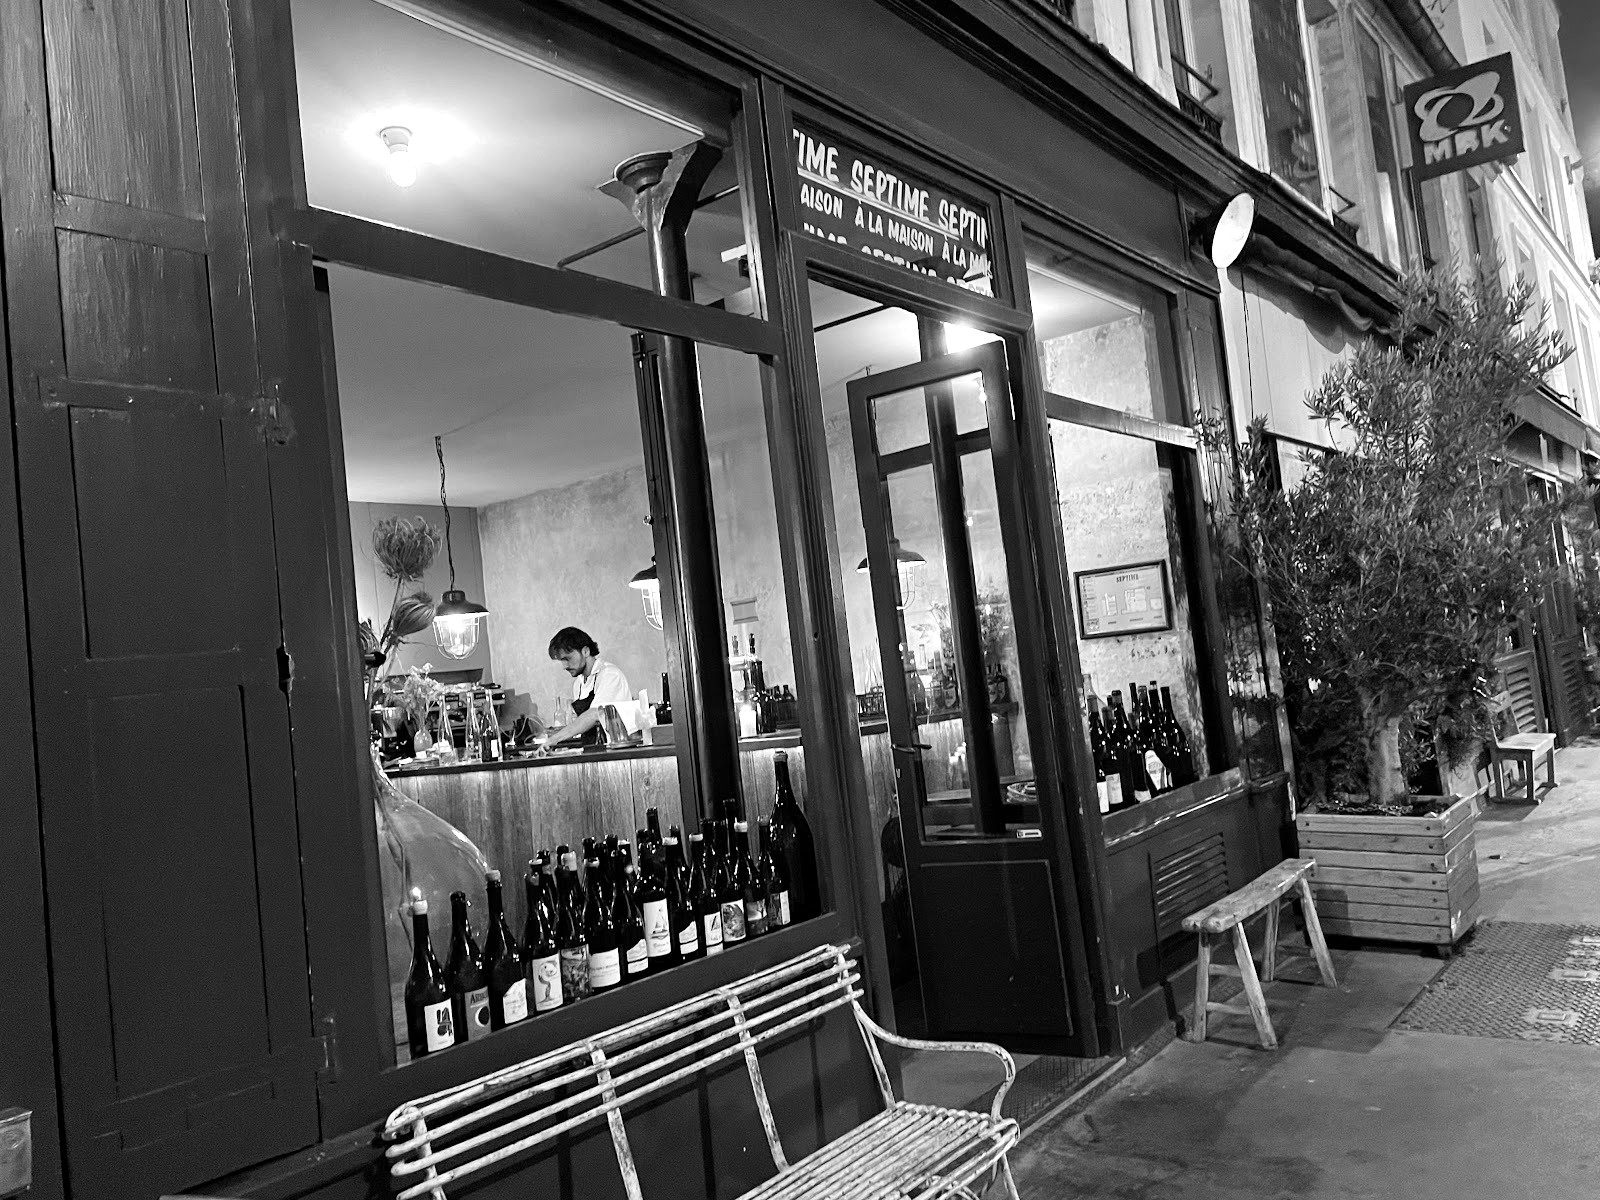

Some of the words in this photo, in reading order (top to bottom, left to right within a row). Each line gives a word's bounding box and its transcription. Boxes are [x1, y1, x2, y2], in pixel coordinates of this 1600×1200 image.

[850, 159, 930, 222] SEPTIME
[868, 211, 884, 237] LA
[888, 218, 934, 257] MAISON
[953, 244, 967, 269] LA
